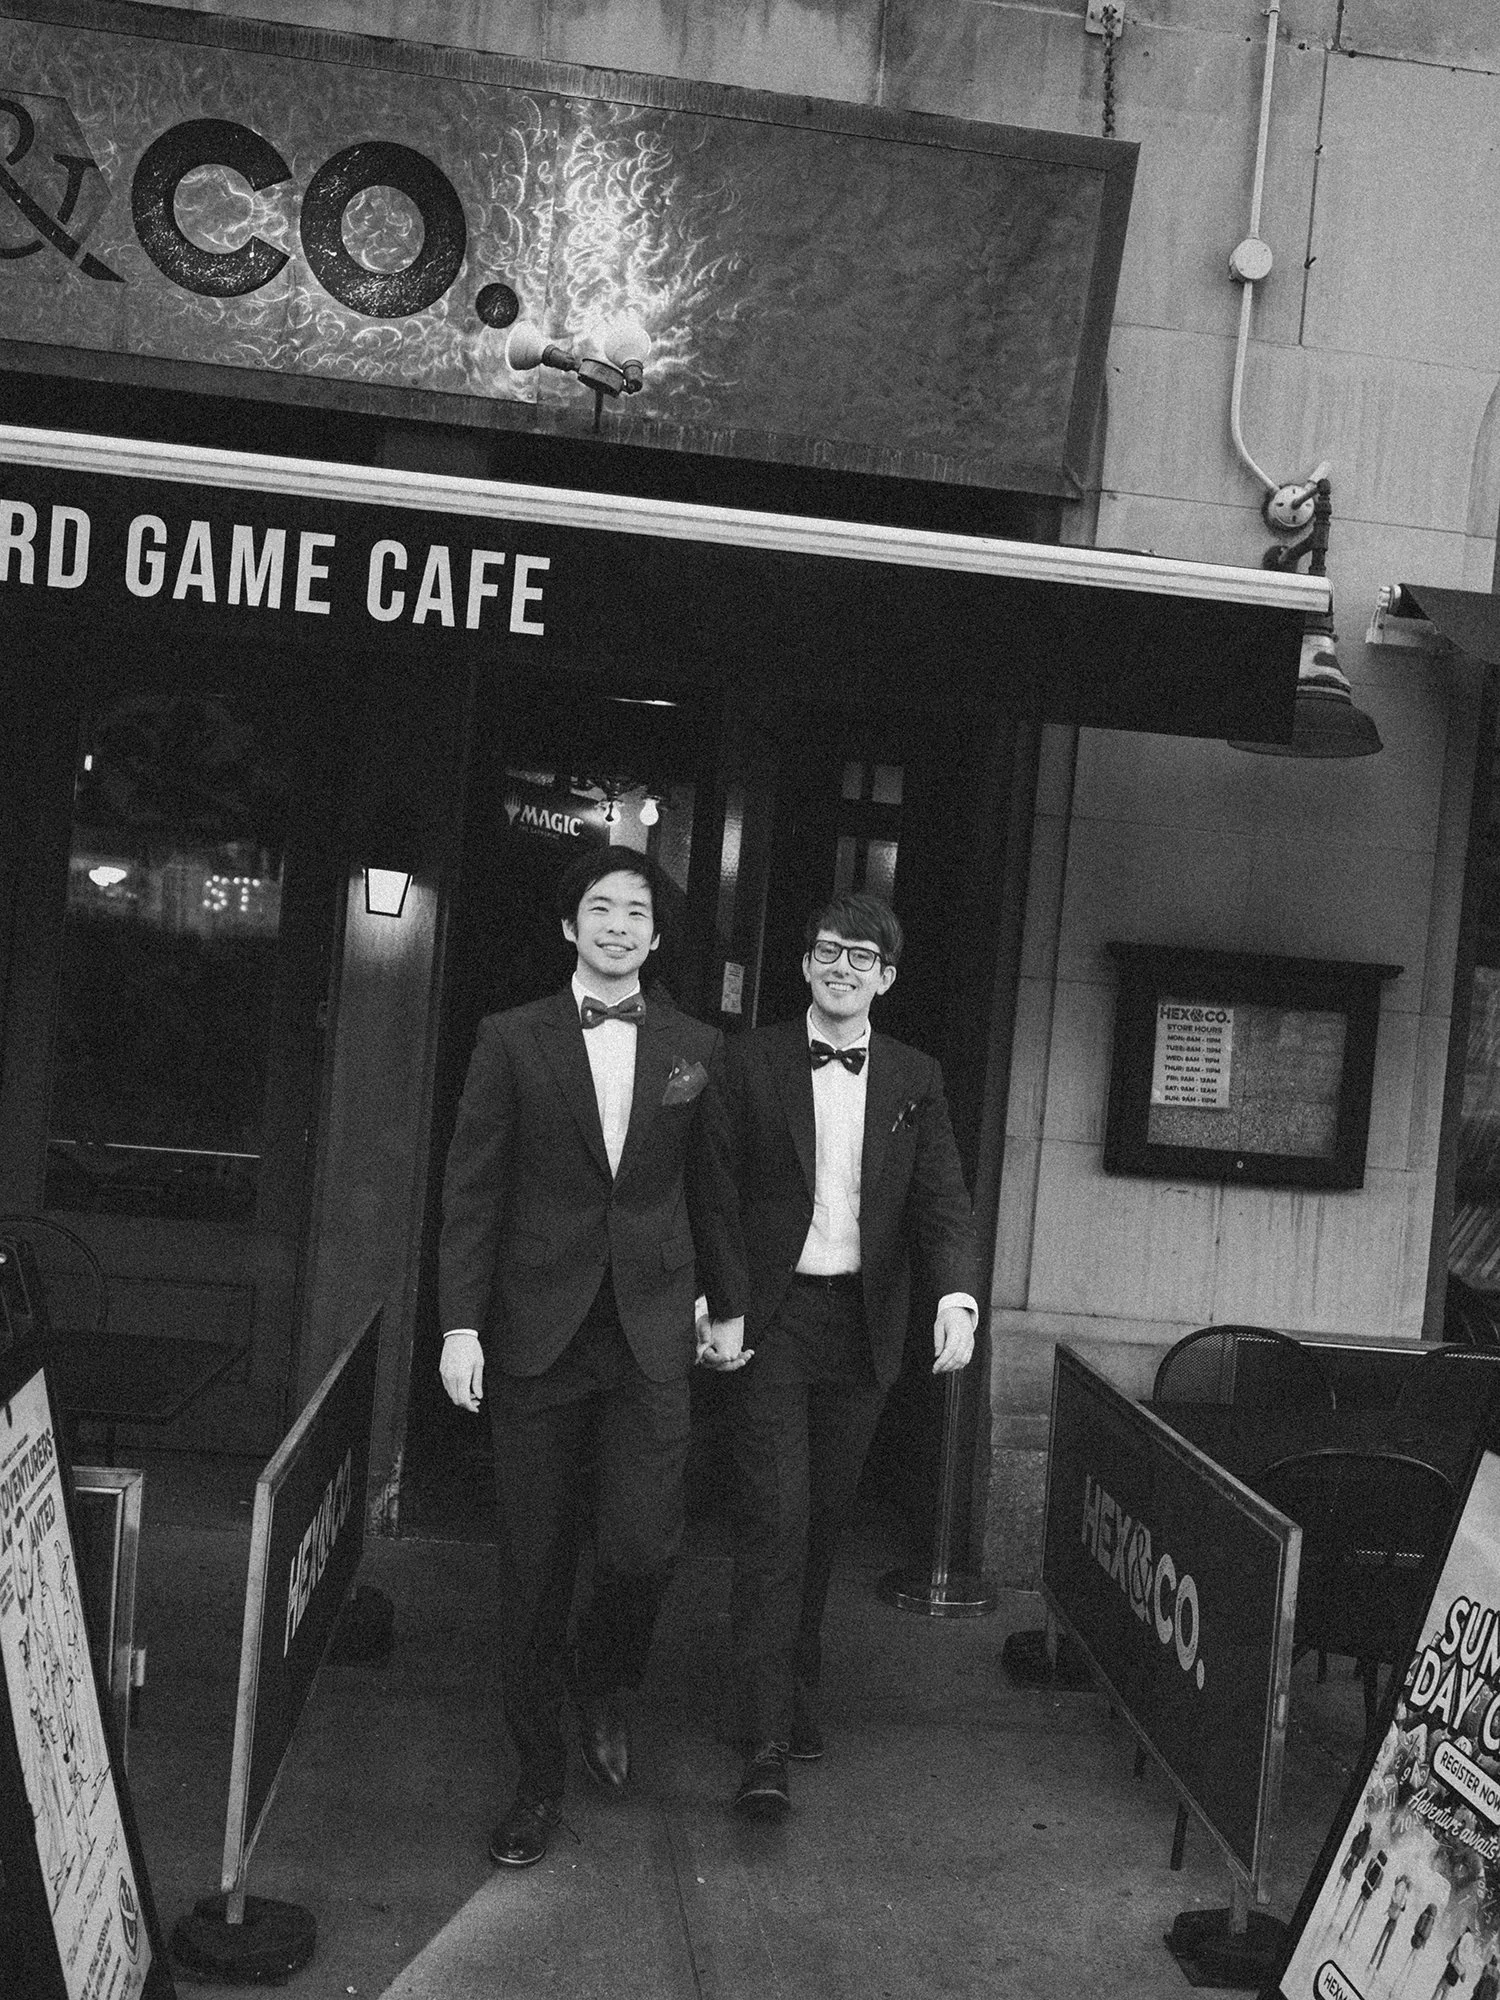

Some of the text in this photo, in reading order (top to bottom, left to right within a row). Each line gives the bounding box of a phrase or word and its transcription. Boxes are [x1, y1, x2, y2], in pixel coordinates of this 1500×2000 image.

[0, 498, 551, 636] RD GAME CAFE
[520, 804, 584, 837] MAGIC
[1167, 1024, 1222, 1034] STORE HOURS
[0, 1427, 53, 1518] DVENTURERS
[26, 1493, 56, 1556] ANTED
[1081, 1472, 1205, 1690] HEX&CO.
[1408, 1648, 1486, 1730] DAY
[1440, 1750, 1481, 1794] REGISTER
[1407, 1788, 1463, 1836] Adventure
